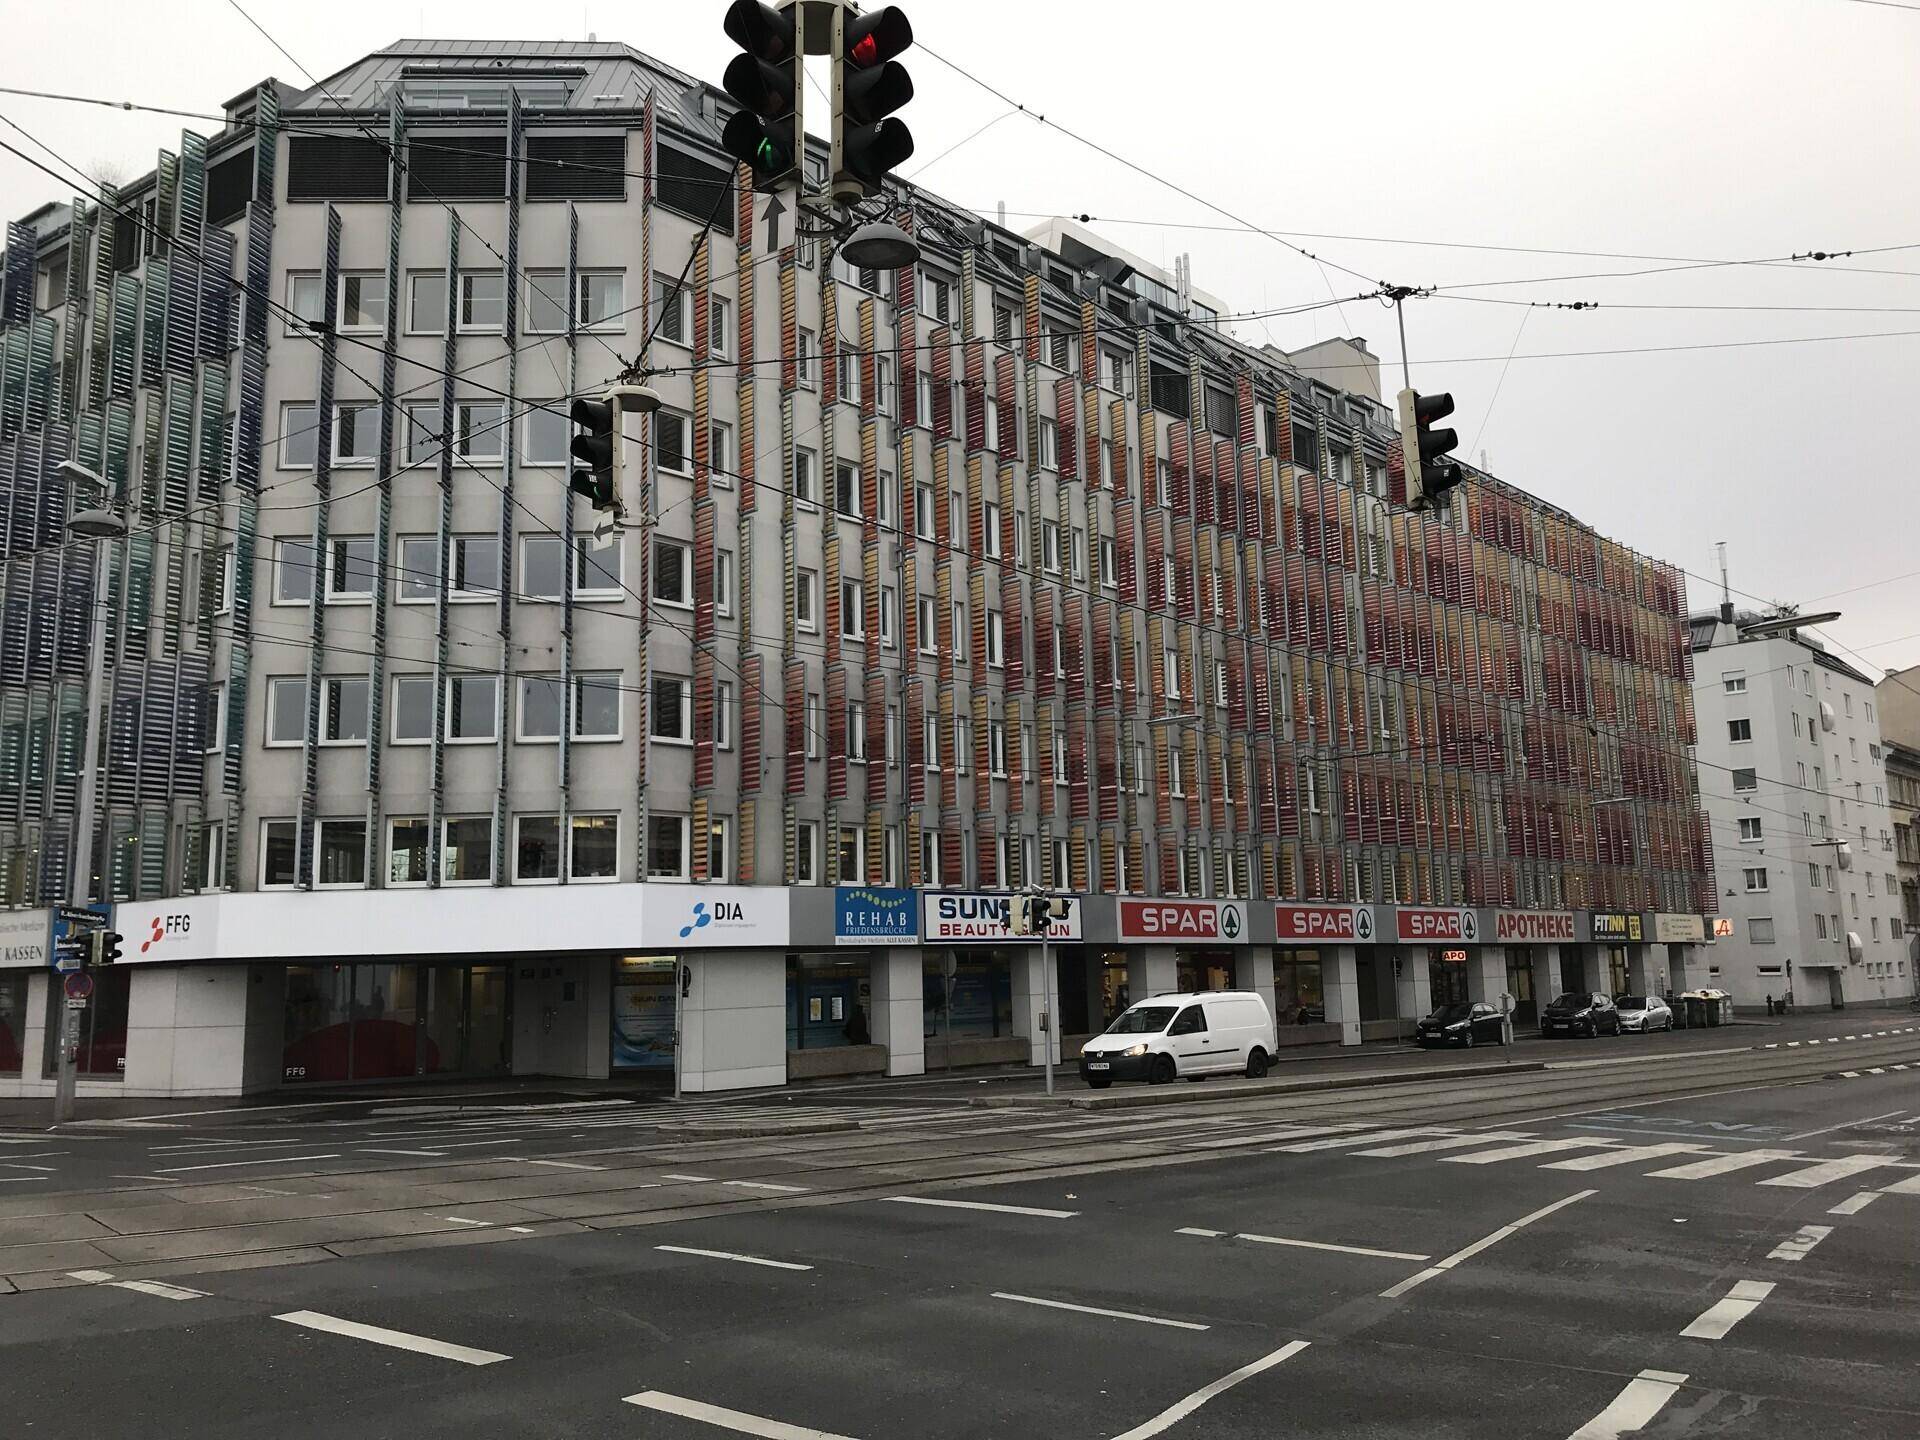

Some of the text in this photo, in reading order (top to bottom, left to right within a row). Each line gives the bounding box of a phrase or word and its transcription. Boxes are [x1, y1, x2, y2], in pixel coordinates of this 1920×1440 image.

[714, 902, 744, 921] DIA
[846, 911, 907, 926] REHAB
[1142, 907, 1217, 932] SPAR
[166, 914, 191, 934] FFG
[846, 925, 907, 934] FRIEDENSBRÜCKE
[939, 923, 1010, 937] BEAUTY
[1293, 912, 1353, 934] SPAR
[1411, 914, 1460, 935] SPAR
[1497, 913, 1574, 938] APOTHEKE
[1594, 914, 1626, 932] FITINN
[5, 945, 43, 961] KASSEN
[1444, 951, 1465, 960] APO
[286, 1067, 306, 1077] FFG
